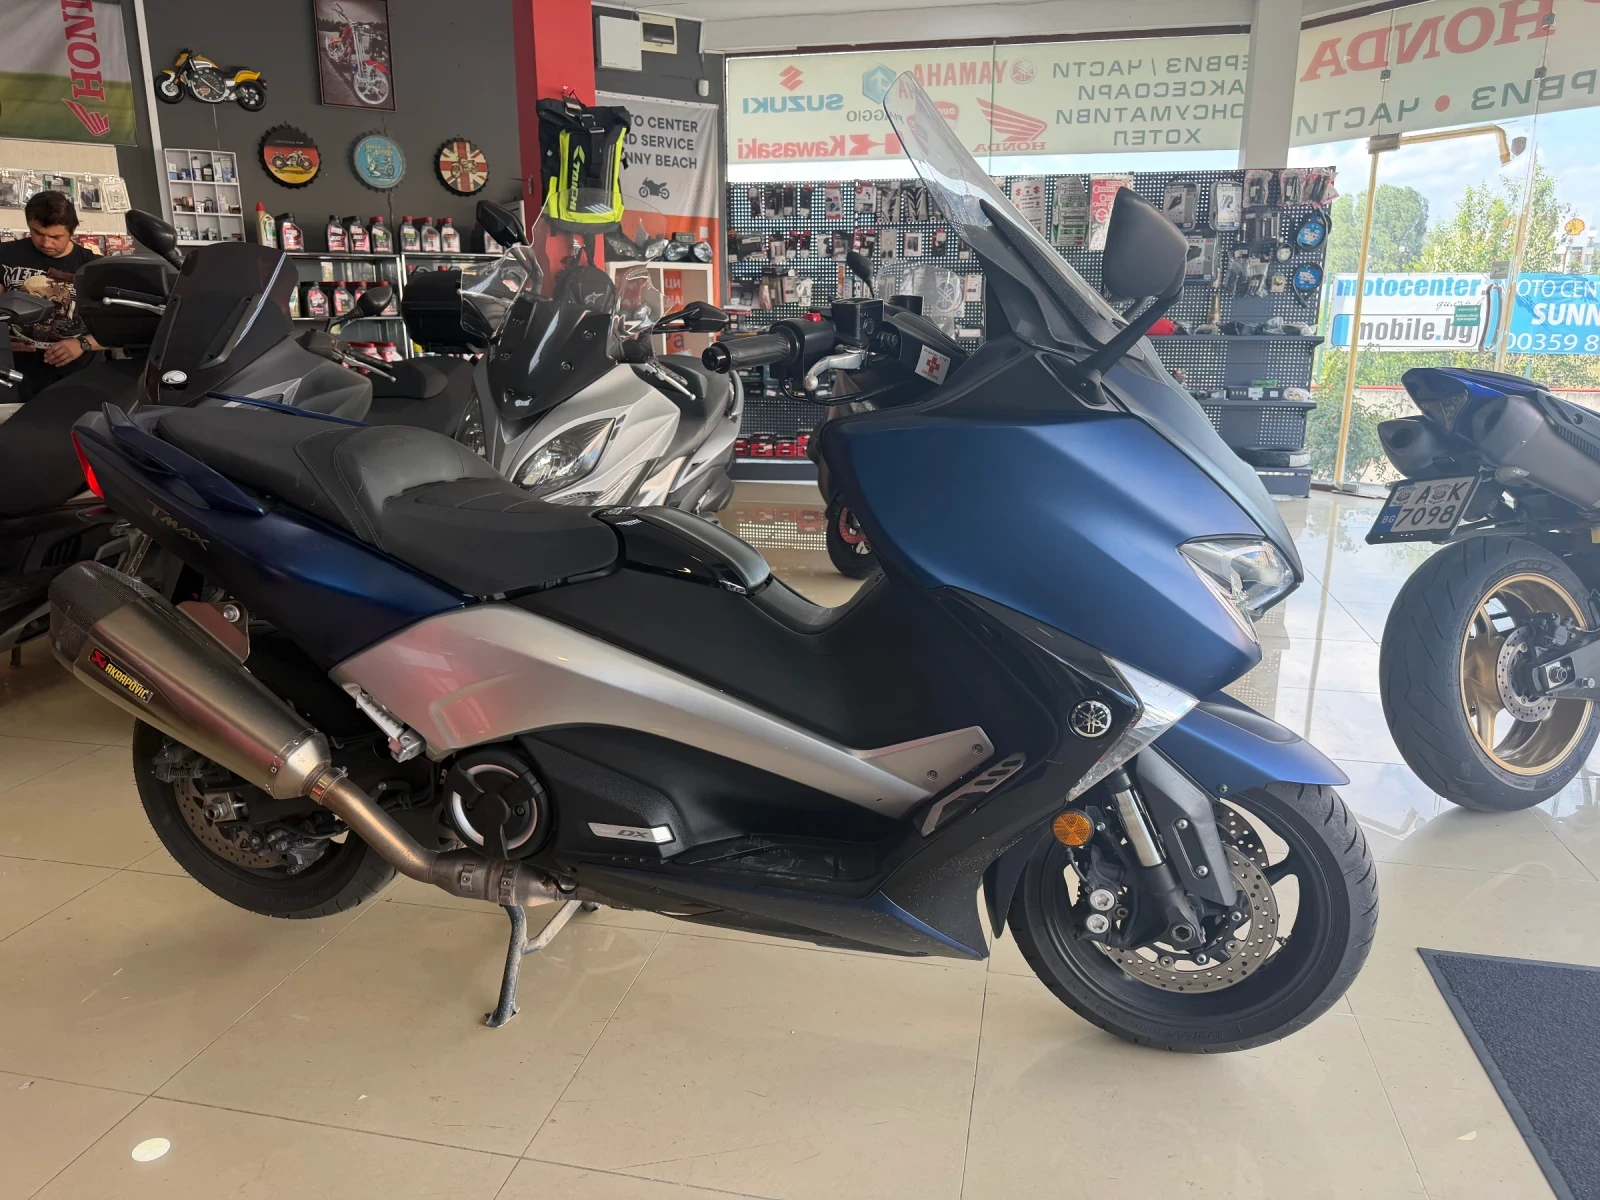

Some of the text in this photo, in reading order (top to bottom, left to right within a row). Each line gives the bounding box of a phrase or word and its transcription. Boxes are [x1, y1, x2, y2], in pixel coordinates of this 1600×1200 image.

[647, 116, 698, 133] CENTER
[641, 134, 694, 151] SERVICE
[624, 151, 698, 169] NNY BEACH
[569, 160, 581, 211] TAICHI
[1516, 279, 1600, 298] OTO CEN
[1531, 302, 1600, 326] SUNN
[1584, 334, 1600, 351] 8
[1415, 481, 1468, 505] A K
[1381, 504, 1456, 528] BG 7098
